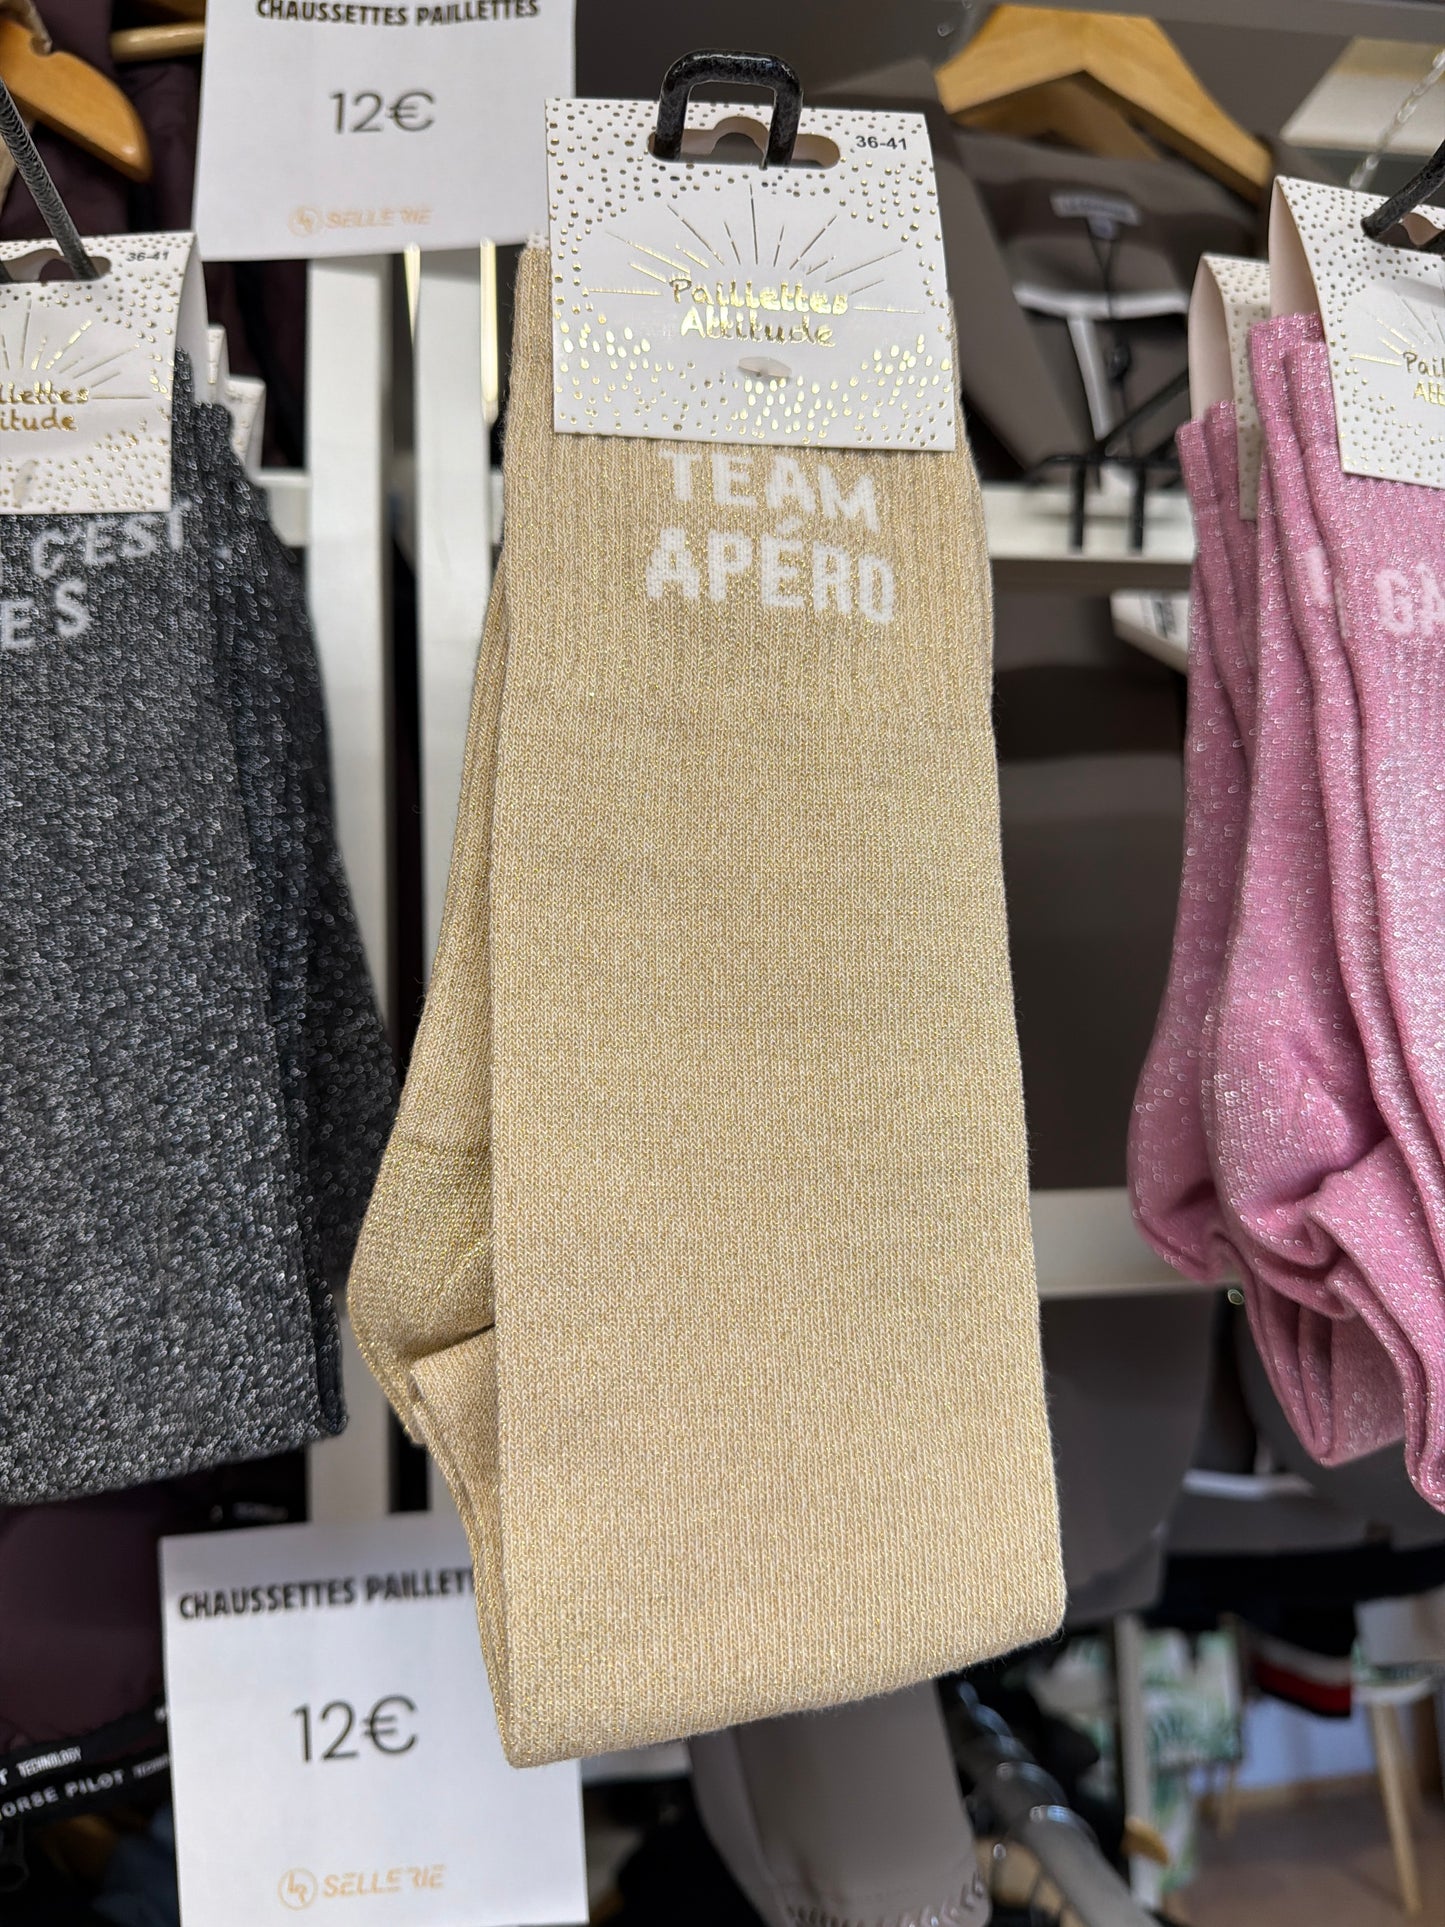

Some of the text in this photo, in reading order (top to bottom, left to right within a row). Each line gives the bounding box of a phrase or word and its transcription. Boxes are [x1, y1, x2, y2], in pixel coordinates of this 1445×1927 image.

[257, 0, 539, 26] CHAUSSETTES PAILLETTES
[329, 88, 436, 134] 12€
[855, 134, 907, 152] 36-41
[668, 276, 849, 315] Paillettes
[680, 304, 836, 347] Attitude
[658, 449, 880, 534] TEAM
[645, 514, 895, 625] APÉRO
[179, 1566, 475, 1620] CHAUSSETTES PAILLETT
[294, 1694, 418, 1764] 12€
[0, 1786, 59, 1821] ORSE
[65, 1768, 124, 1798] PILOT
